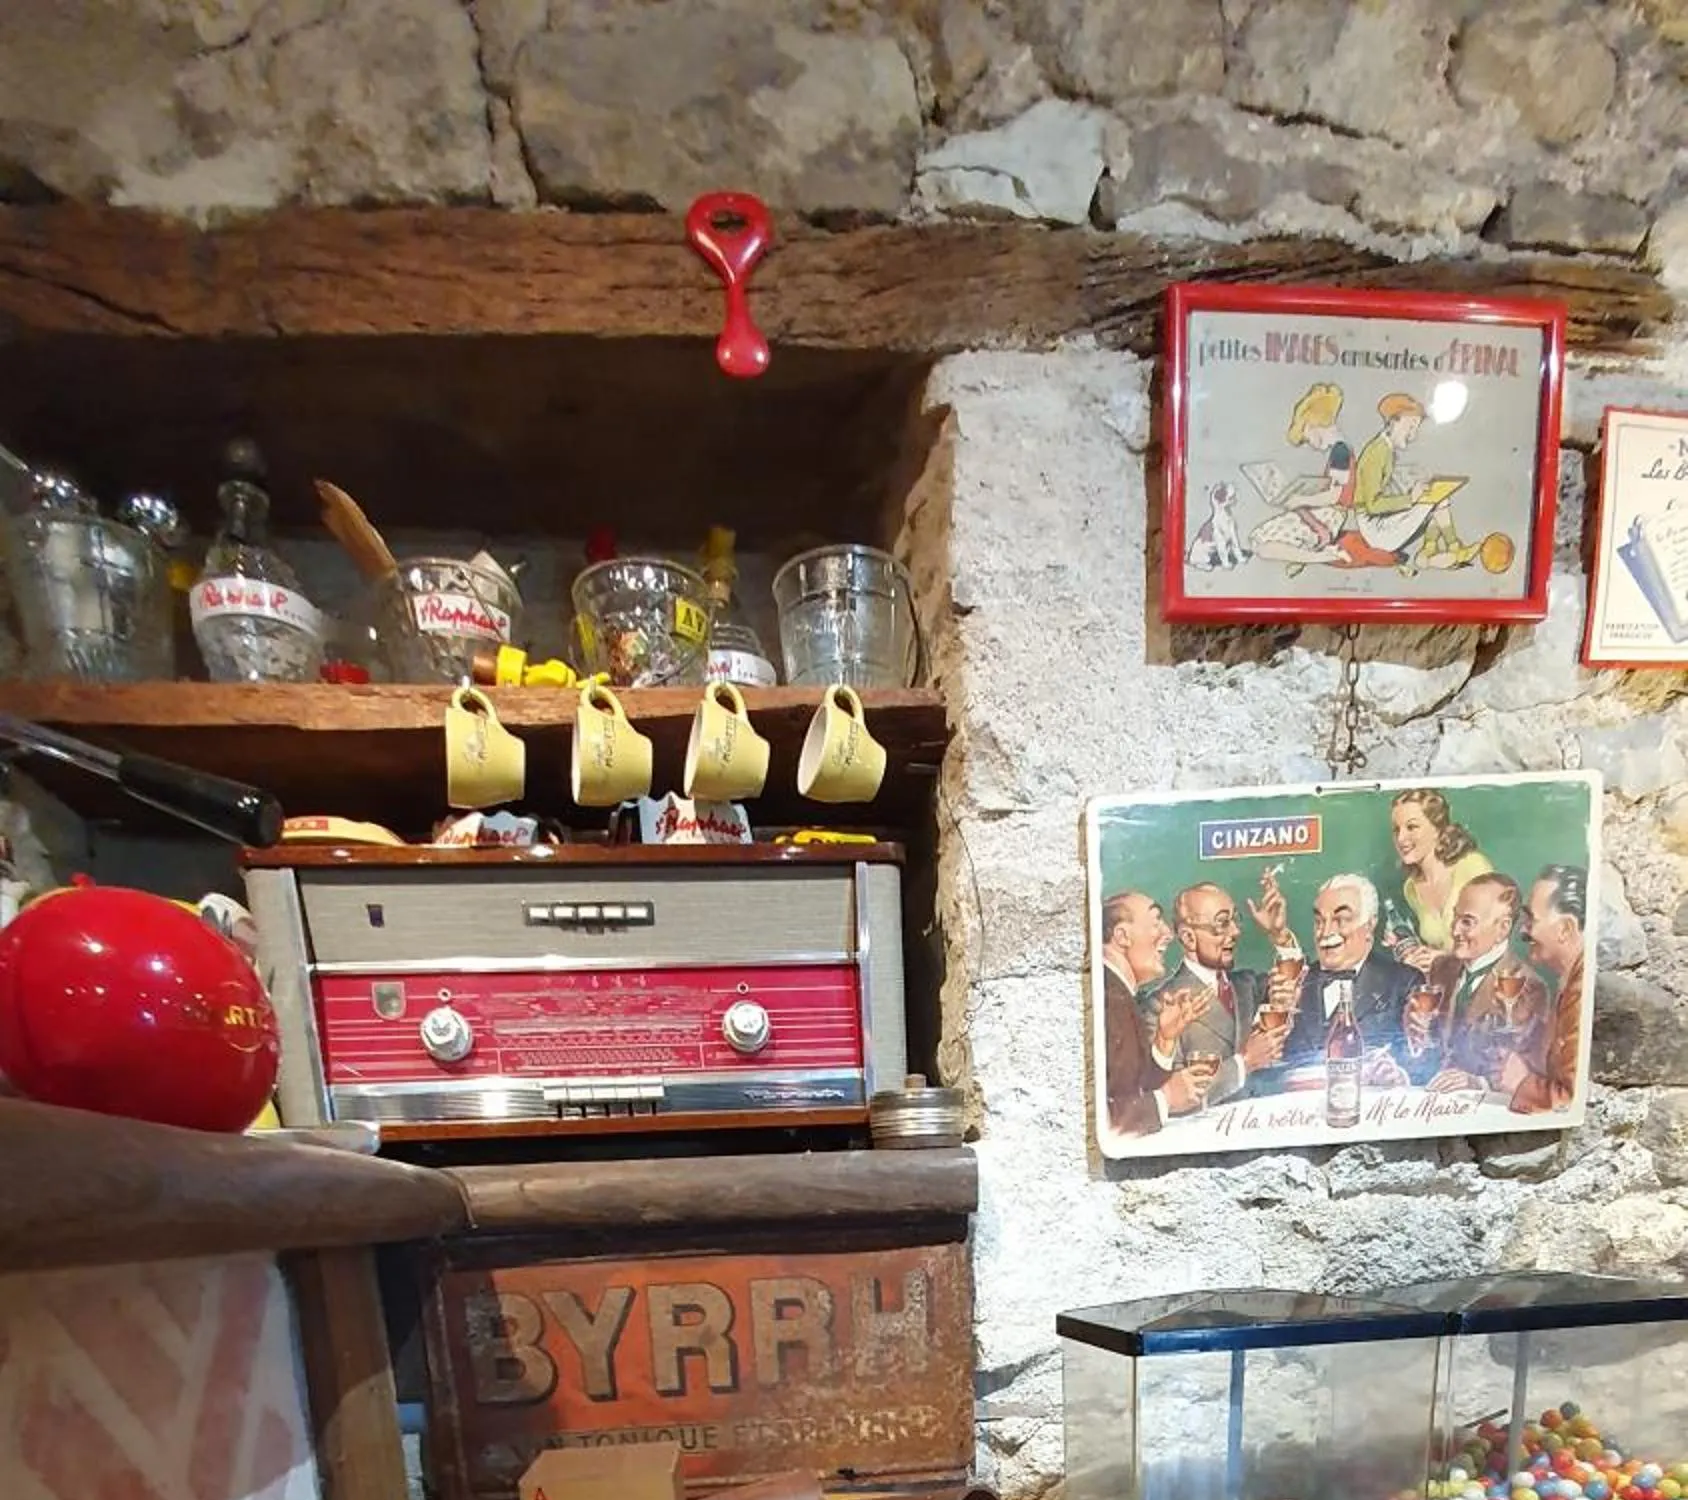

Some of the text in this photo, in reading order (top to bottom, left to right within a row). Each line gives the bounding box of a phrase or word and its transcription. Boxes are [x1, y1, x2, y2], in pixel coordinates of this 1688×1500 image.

[1198, 337, 1262, 367] petites
[1264, 331, 1341, 367] IMAGES
[1211, 824, 1310, 849] CINZANO
[1215, 1106, 1238, 1137] A
[1241, 1104, 1260, 1130] la
[1393, 1094, 1411, 1119] le
[465, 1266, 930, 1406] BYRRH
